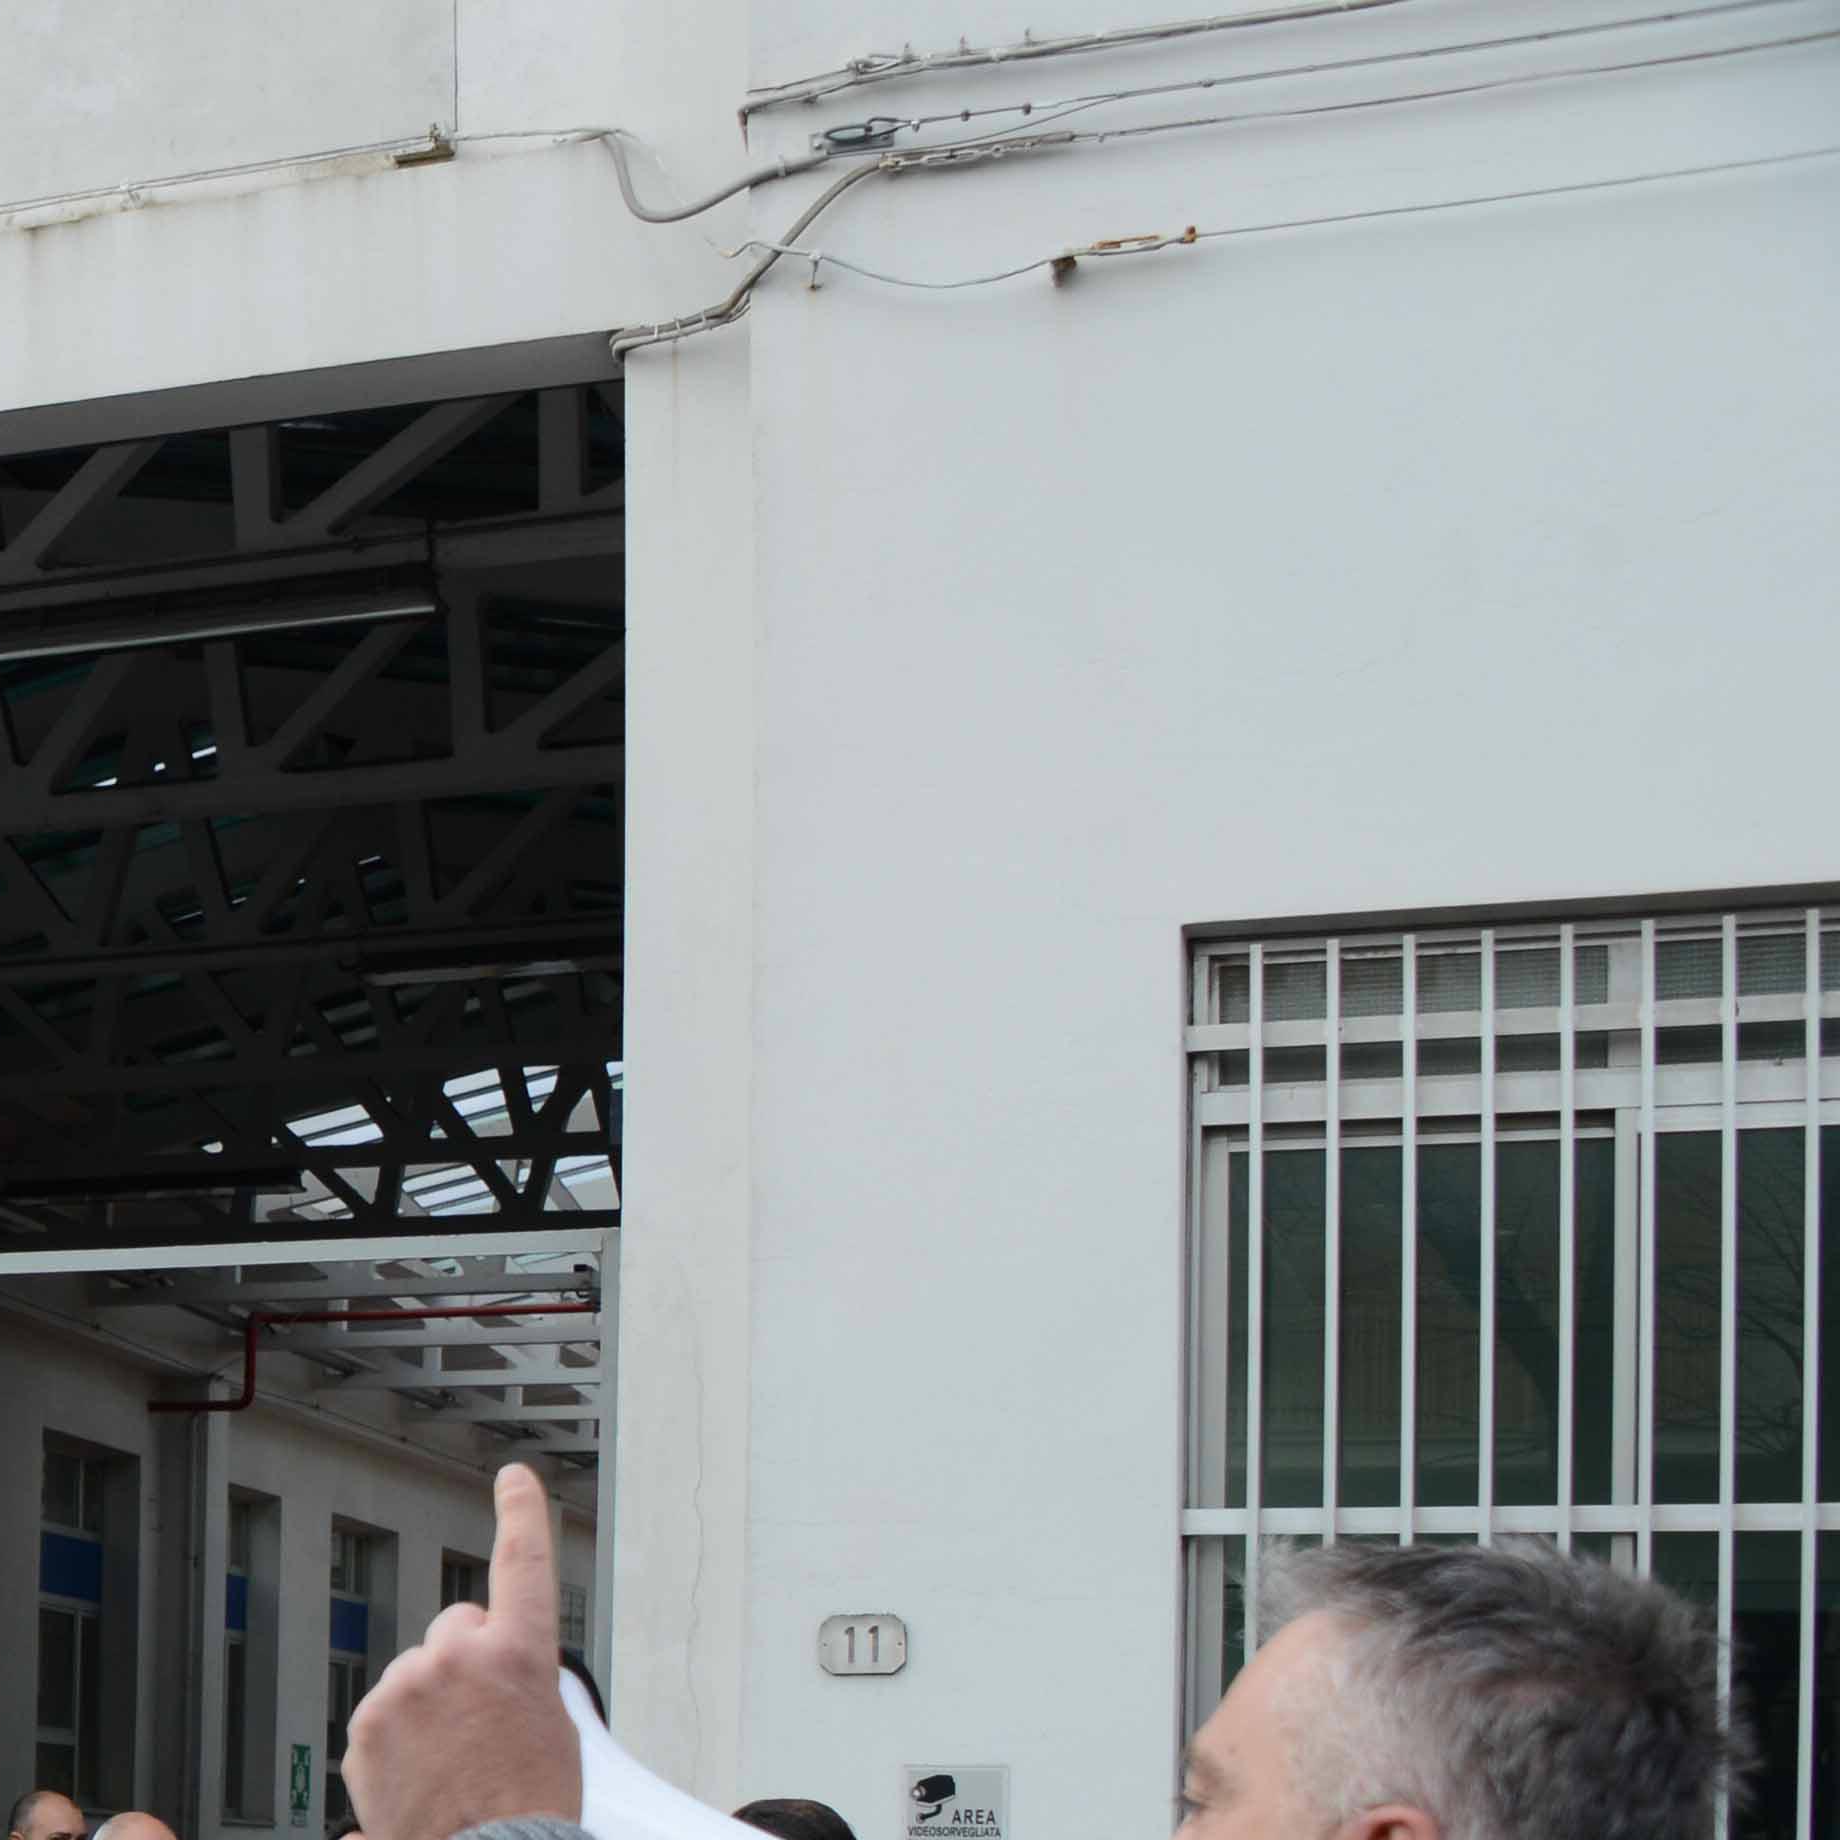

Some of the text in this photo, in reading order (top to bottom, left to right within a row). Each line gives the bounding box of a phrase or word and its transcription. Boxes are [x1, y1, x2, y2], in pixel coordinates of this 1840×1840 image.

[843, 1624, 881, 1665] 11
[951, 1808, 997, 1825] AREA
[907, 1826, 1002, 1838] VIDEOSORVEGLIATA
